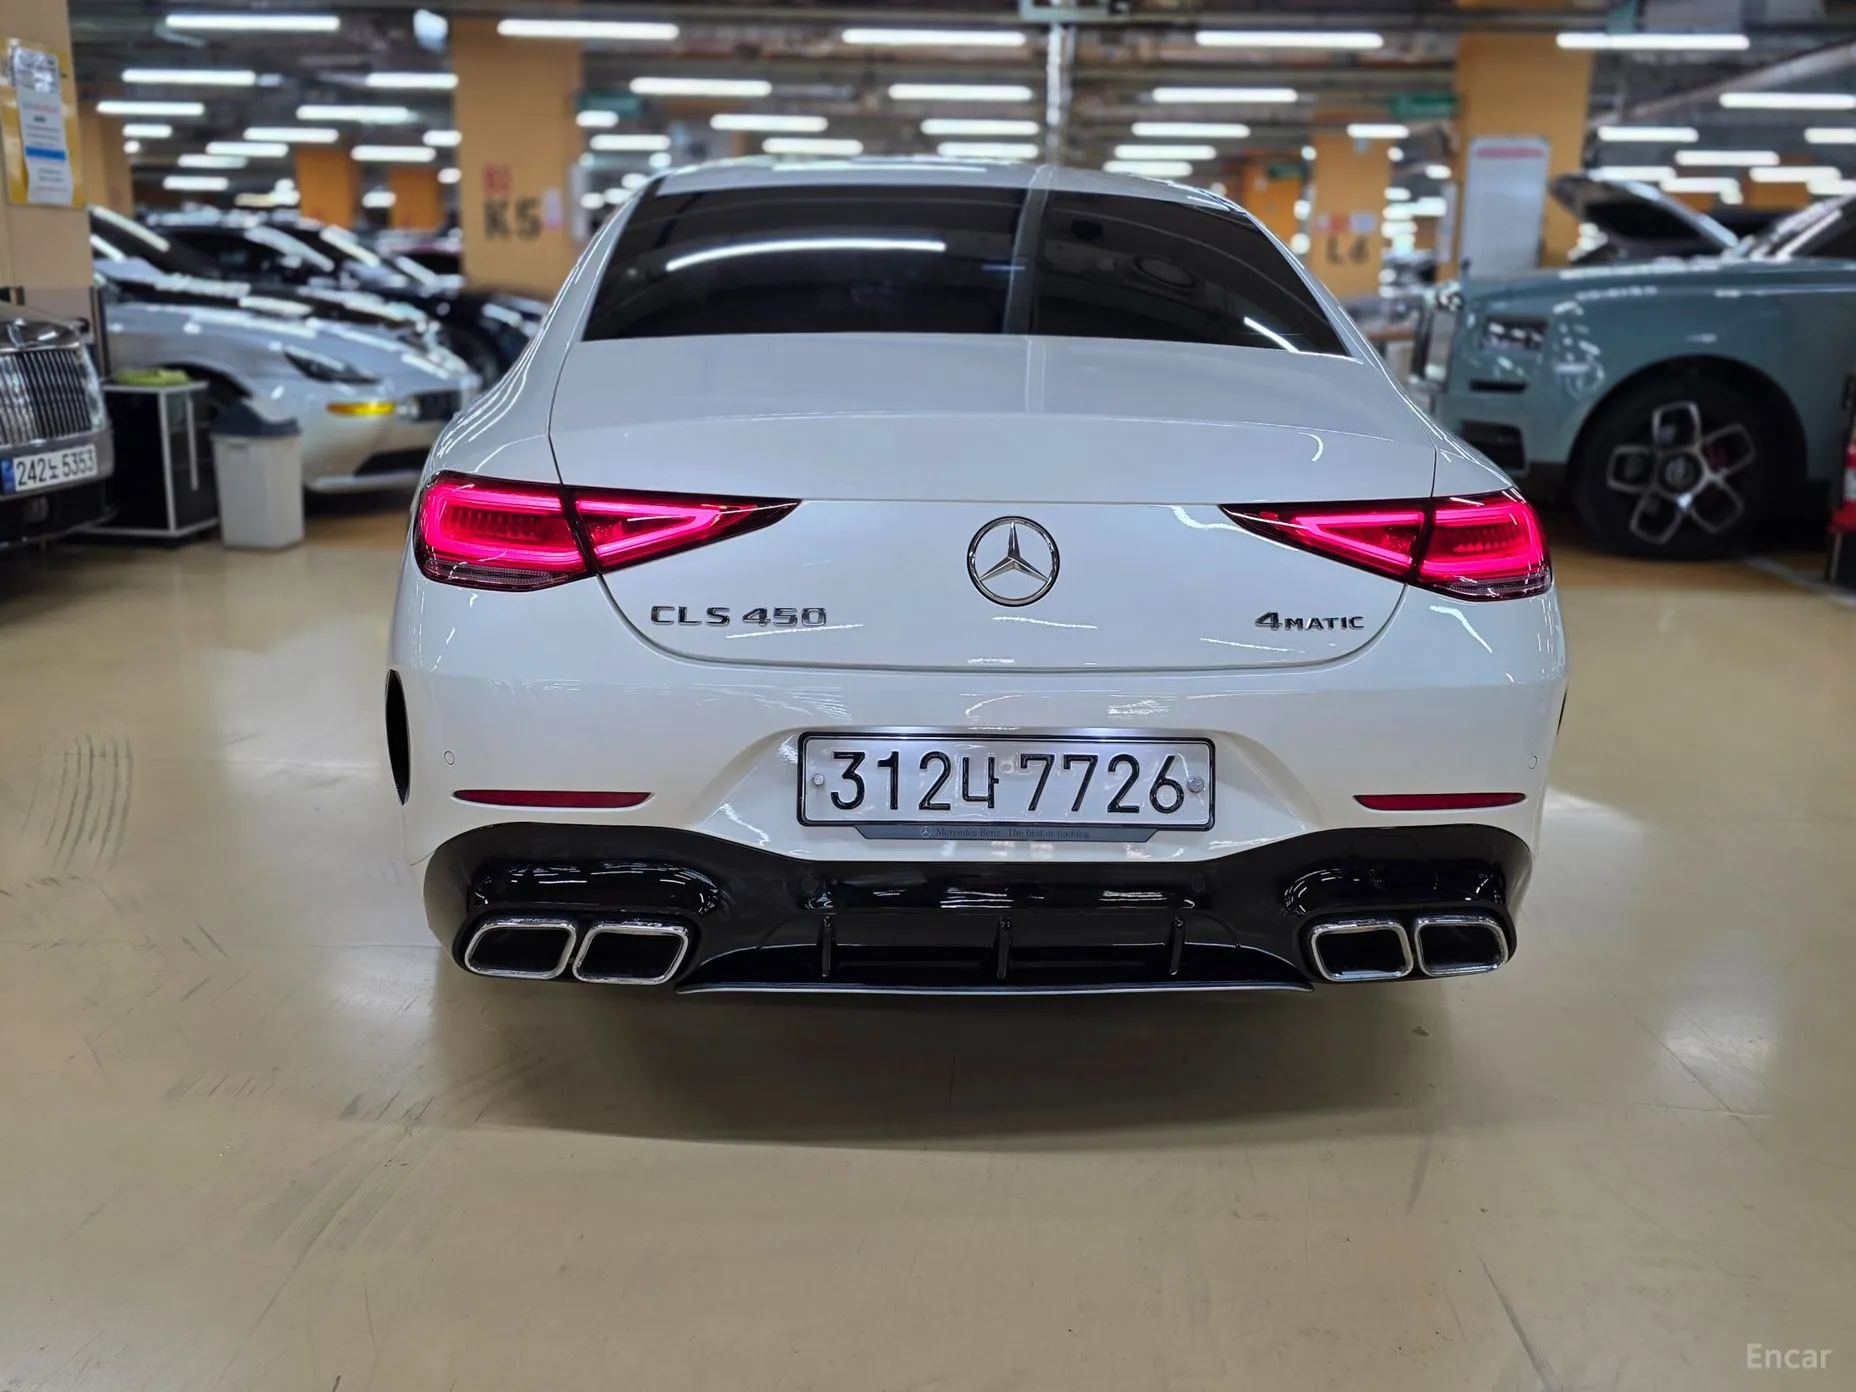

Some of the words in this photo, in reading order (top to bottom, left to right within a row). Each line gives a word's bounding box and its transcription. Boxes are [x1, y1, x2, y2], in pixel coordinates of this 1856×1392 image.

[650, 605, 731, 626] CLS
[742, 607, 827, 627] 450
[1255, 611, 1364, 630] 4MATIC
[1008, 828, 1023, 838] The
[1026, 828, 1044, 838] best
[1046, 830, 1054, 838] or
